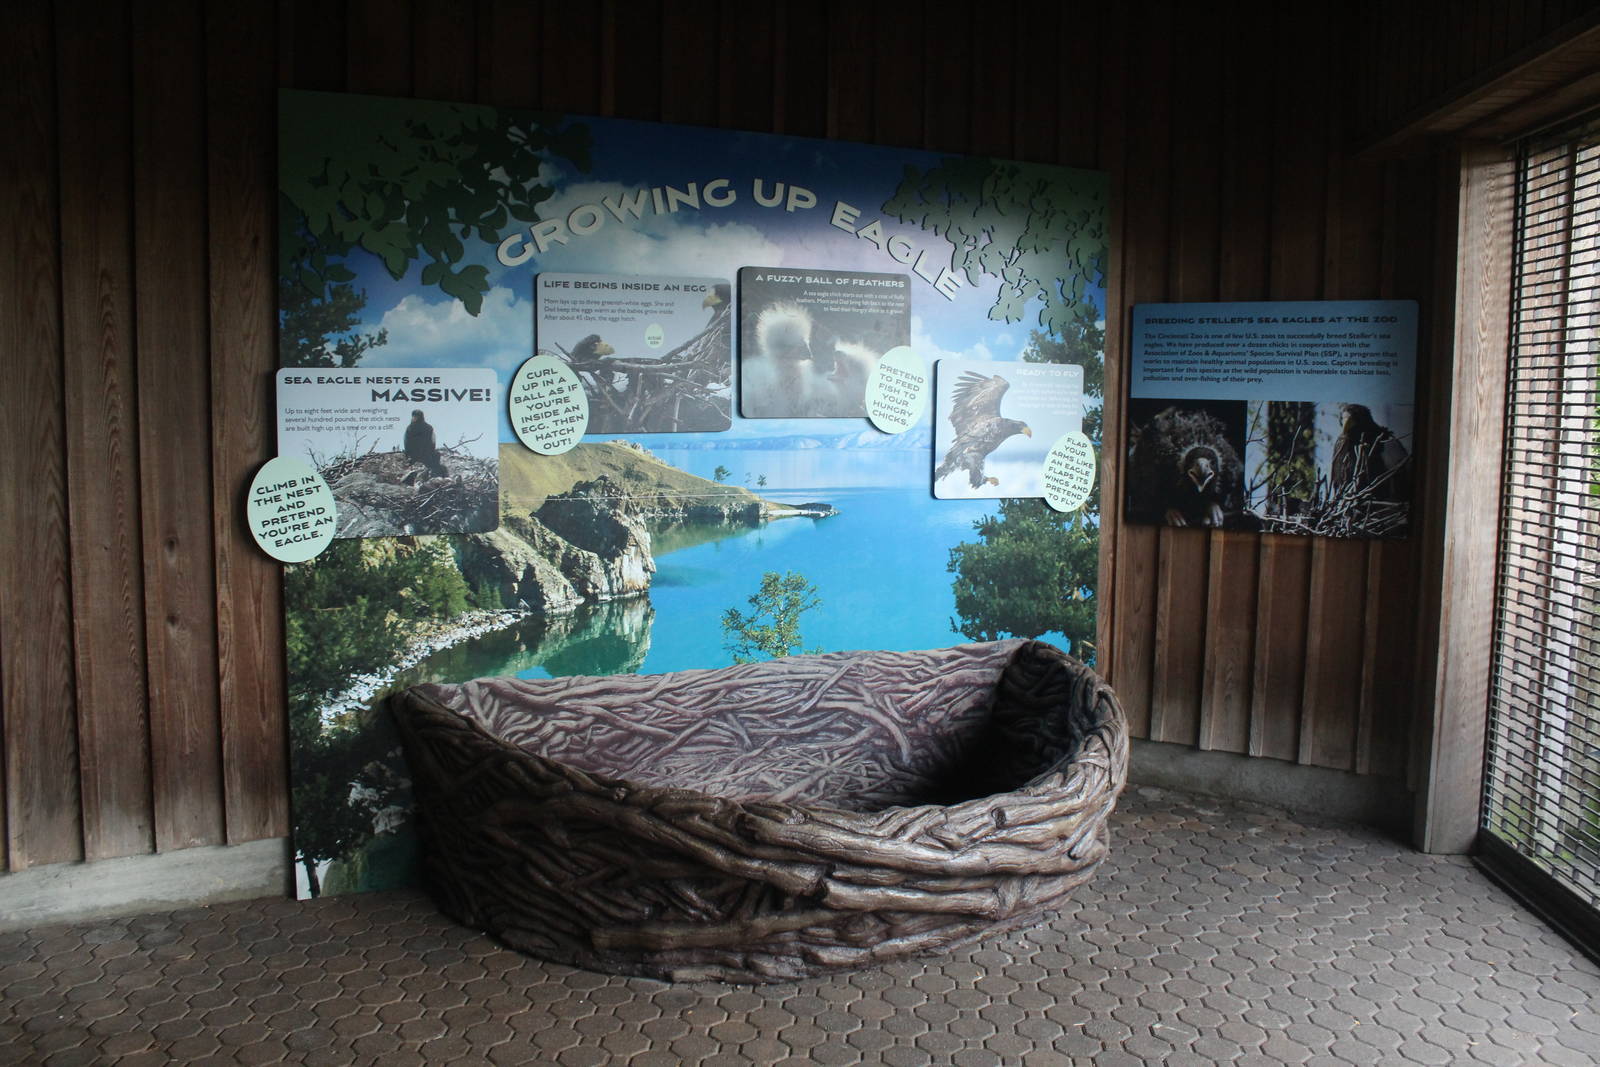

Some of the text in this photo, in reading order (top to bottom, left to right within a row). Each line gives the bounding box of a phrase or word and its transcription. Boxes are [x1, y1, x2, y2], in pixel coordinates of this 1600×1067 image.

[496, 178, 964, 301] GROWING UP EAGLE
[544, 280, 707, 293] LIFE BEGINS INSIDE AN EGG
[767, 275, 803, 283] FUZZY
[805, 277, 832, 285] BALL
[835, 278, 850, 286] OF
[852, 279, 905, 288] FEATHERS
[284, 376, 441, 385] SEA EAGLE NESTS ARE
[526, 368, 558, 380] CURL
[880, 363, 924, 384] PRETEND
[880, 373, 920, 392] TO FEED
[1016, 369, 1080, 378] READY TO FLY
[514, 383, 578, 404] BALL AS IF
[522, 382, 539, 391] UP
[542, 379, 554, 387] IN
[879, 382, 916, 400] FISH TO
[371, 388, 491, 402] MASSIVE!
[526, 396, 571, 411] YOU'RE
[882, 393, 909, 407] YOUR
[521, 404, 580, 424] INSIDE AN
[872, 399, 913, 417] HUNGRY
[521, 414, 585, 434] EGG. THEN
[872, 409, 909, 427] CHICKS.
[535, 426, 575, 441] HATCH
[1067, 437, 1088, 448] FLAP
[543, 437, 572, 450] OUT!
[1064, 445, 1086, 457] YOUR
[1051, 458, 1090, 477] AN EAGLE
[1052, 450, 1094, 469] ARMS LIKE
[1044, 473, 1089, 494] WINGS AND
[1048, 466, 1089, 485] FLAPS ITS
[256, 475, 315, 495] CLIMB IN
[1046, 483, 1082, 500] PRETEND
[254, 485, 321, 507] THE NEST
[1048, 493, 1059, 501] TO
[277, 500, 306, 513] AND
[261, 507, 325, 528] PRETEND
[258, 516, 333, 540] YOU'RE AN
[274, 530, 323, 548] EAGLE.
